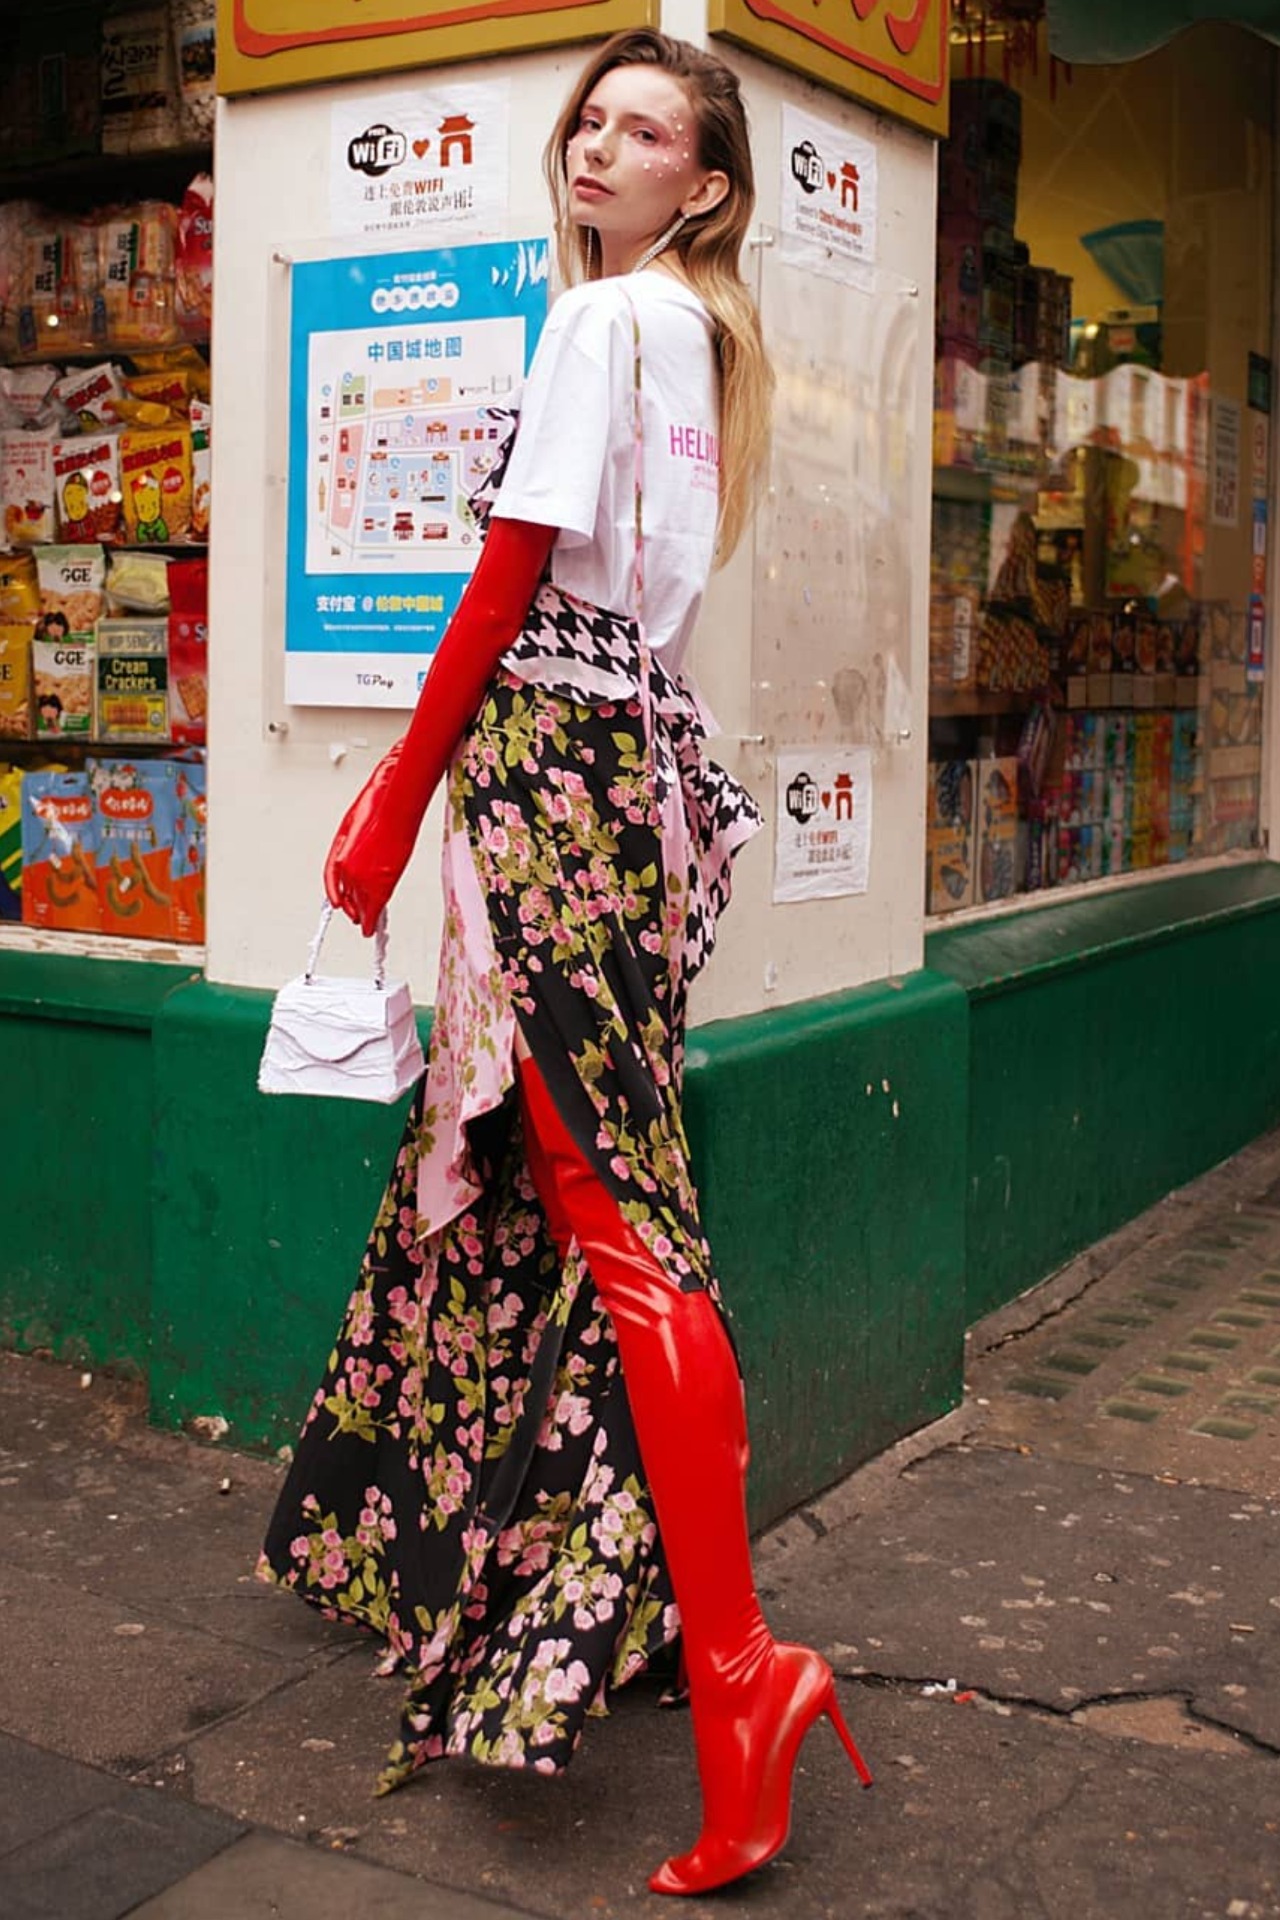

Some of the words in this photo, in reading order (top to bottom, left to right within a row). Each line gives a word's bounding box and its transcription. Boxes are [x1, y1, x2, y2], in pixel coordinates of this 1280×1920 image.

[54, 650, 86, 666] GGE
[112, 658, 148, 675] Cream
[105, 674, 157, 691] Crackers
